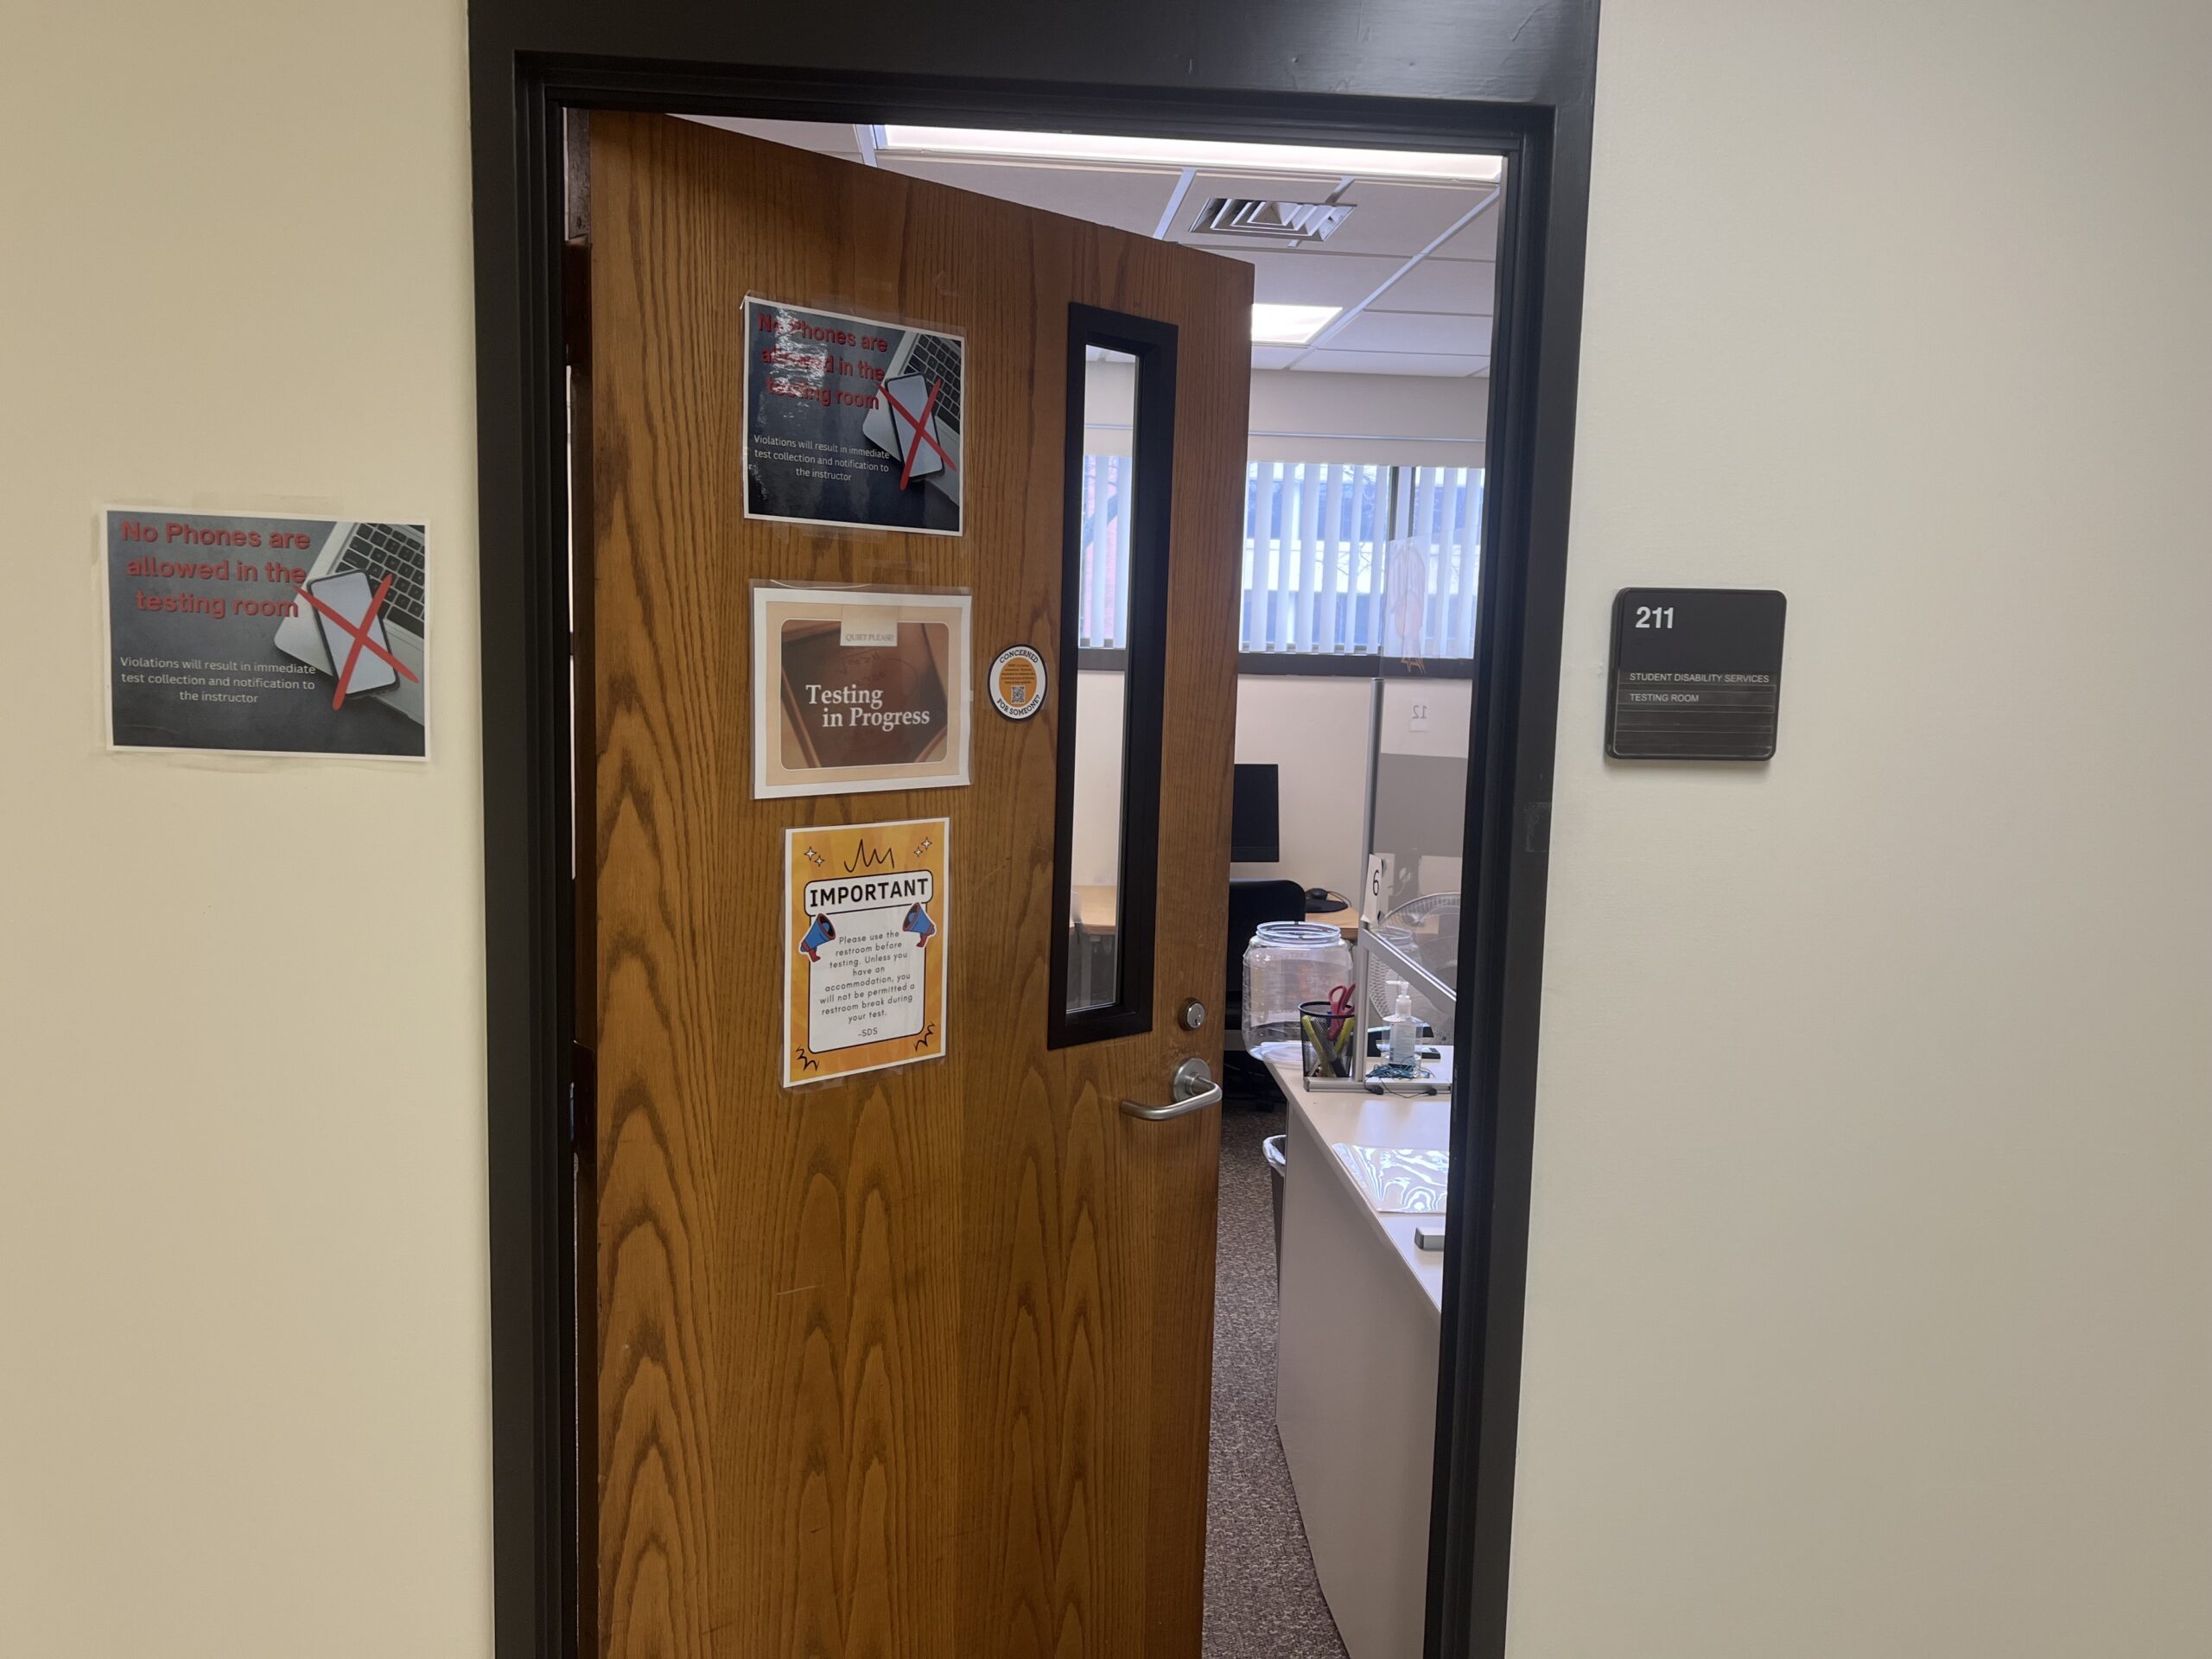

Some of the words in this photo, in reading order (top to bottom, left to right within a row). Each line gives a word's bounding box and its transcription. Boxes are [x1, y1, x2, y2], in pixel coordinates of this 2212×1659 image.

[788, 317, 856, 347] Phones
[861, 335, 888, 353] are
[838, 358, 854, 376] in
[857, 359, 885, 382] the
[836, 388, 880, 410] room
[753, 434, 797, 448] Violations
[798, 440, 813, 450] will
[815, 442, 838, 453] result
[840, 445, 848, 454] in
[849, 446, 890, 460] immediate
[754, 449, 772, 460] test
[773, 452, 816, 464] collection
[817, 456, 833, 466] and
[835, 459, 879, 471] notification
[880, 464, 889, 473] to
[796, 467, 810, 477] the
[811, 468, 852, 481] instructor
[121, 521, 159, 543] No
[166, 522, 262, 548] Phones
[270, 531, 311, 550] are
[127, 556, 230, 581] allowed
[237, 560, 258, 582] in
[265, 562, 307, 584] the
[136, 590, 226, 620] testing
[233, 599, 299, 618] room
[1636, 607, 1675, 629] 211
[120, 657, 179, 669] Violations
[181, 659, 202, 670] will
[204, 660, 238, 671] result
[240, 662, 251, 671] in
[253, 662, 316, 675] immediate
[999, 649, 1039, 664] CONCERNED
[121, 673, 145, 683] test
[148, 674, 206, 686] collection
[208, 677, 230, 687] and
[232, 677, 300, 690] notification
[302, 680, 315, 690] to
[1630, 672, 1672, 682] STUDENT
[1674, 673, 1721, 683] DISABILITY
[1724, 674, 1770, 683] SERVICES
[179, 691, 199, 701] the
[201, 692, 258, 703] instructor
[806, 683, 883, 709] Testing
[997, 698, 1009, 713] FOR
[1630, 693, 1669, 702] TESTING
[1671, 694, 1700, 702] ROOM
[823, 708, 843, 728] in
[849, 708, 931, 732] Progress
[810, 878, 929, 907] IMPORTANT
[1372, 869, 1380, 896] 6
[836, 946, 873, 957] restroom
[875, 942, 902, 950] before
[839, 936, 867, 945] Please
[830, 959, 861, 969] testing.
[865, 954, 891, 963] Unless
[893, 952, 907, 962] you
[825, 977, 894, 992] accommodation,
[897, 974, 911, 983] you
[819, 995, 835, 1004] will
[837, 993, 851, 1001] not
[868, 983, 907, 998] permitted
[822, 1004, 859, 1015] restroom
[861, 998, 885, 1008] break
[887, 995, 913, 1005] during
[849, 1014, 867, 1024] your
[868, 1009, 887, 1018] test.
[858, 1027, 878, 1037] -SDS
